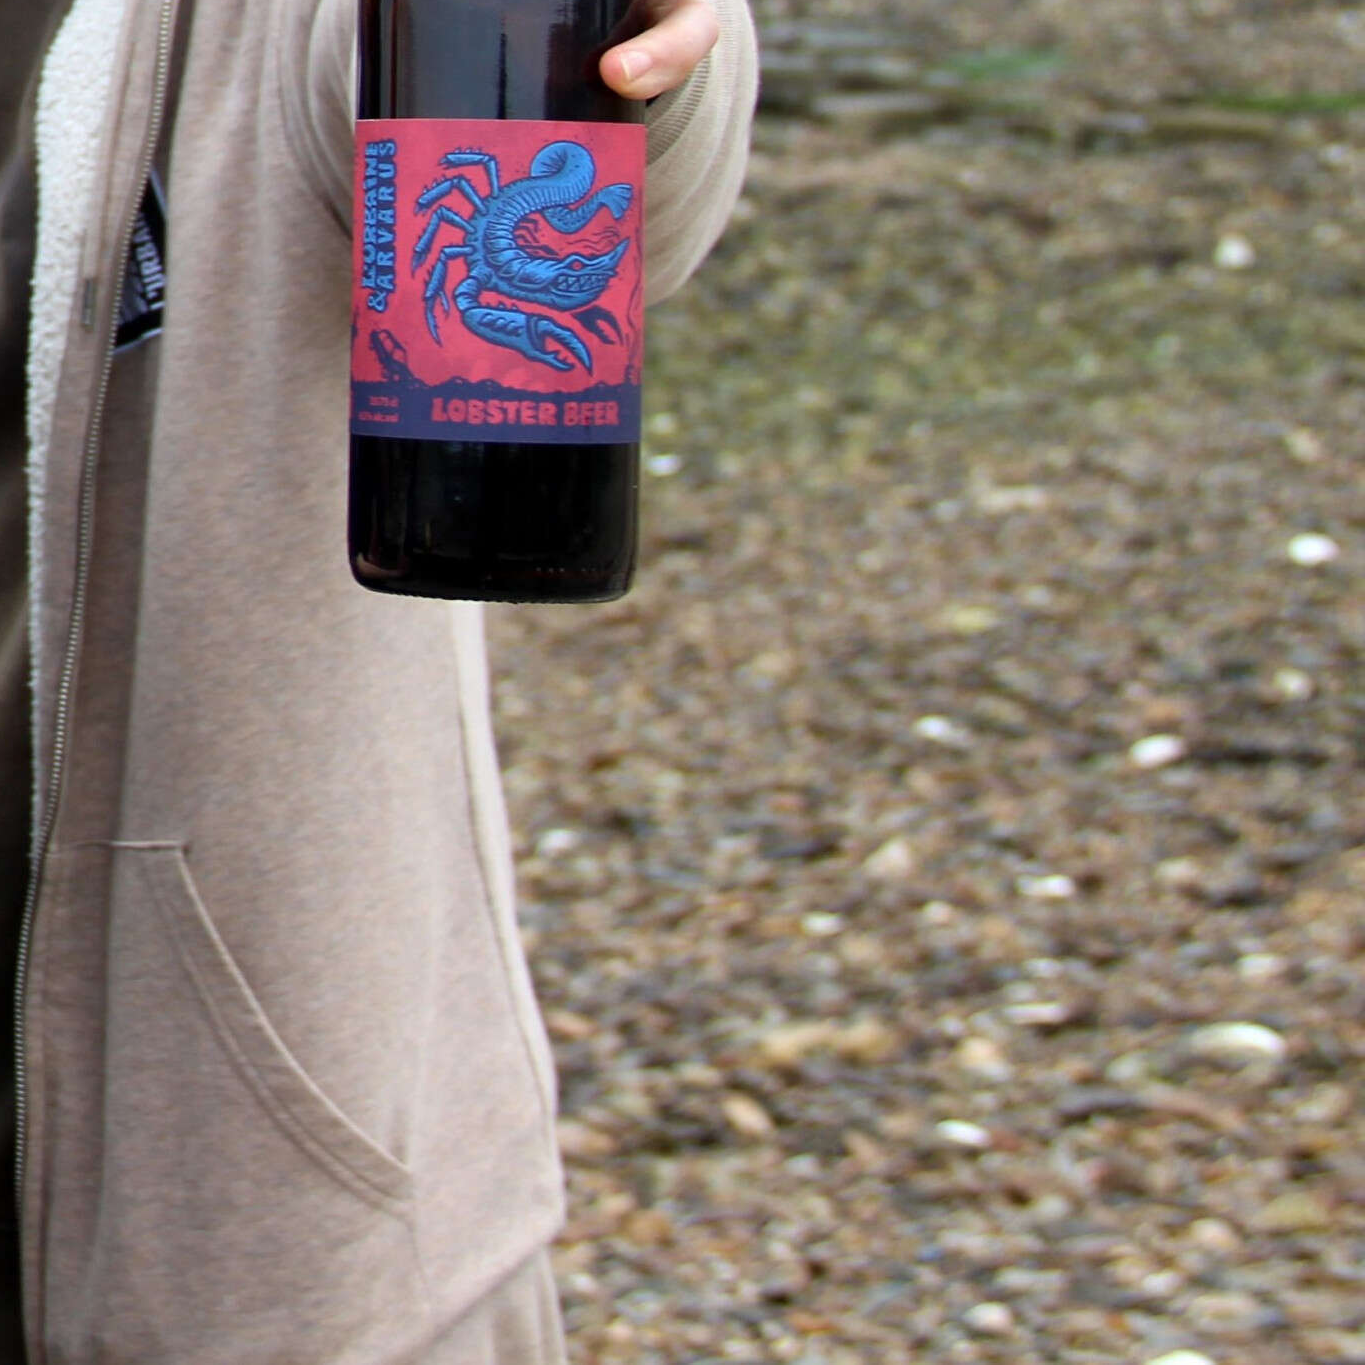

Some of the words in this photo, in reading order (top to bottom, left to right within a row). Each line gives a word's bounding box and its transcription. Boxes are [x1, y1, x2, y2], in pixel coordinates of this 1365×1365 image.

[367, 291, 387, 313] &
[377, 142, 397, 290] ARVARUS
[432, 398, 557, 426] LOBSTER
[564, 402, 619, 426] BEER
